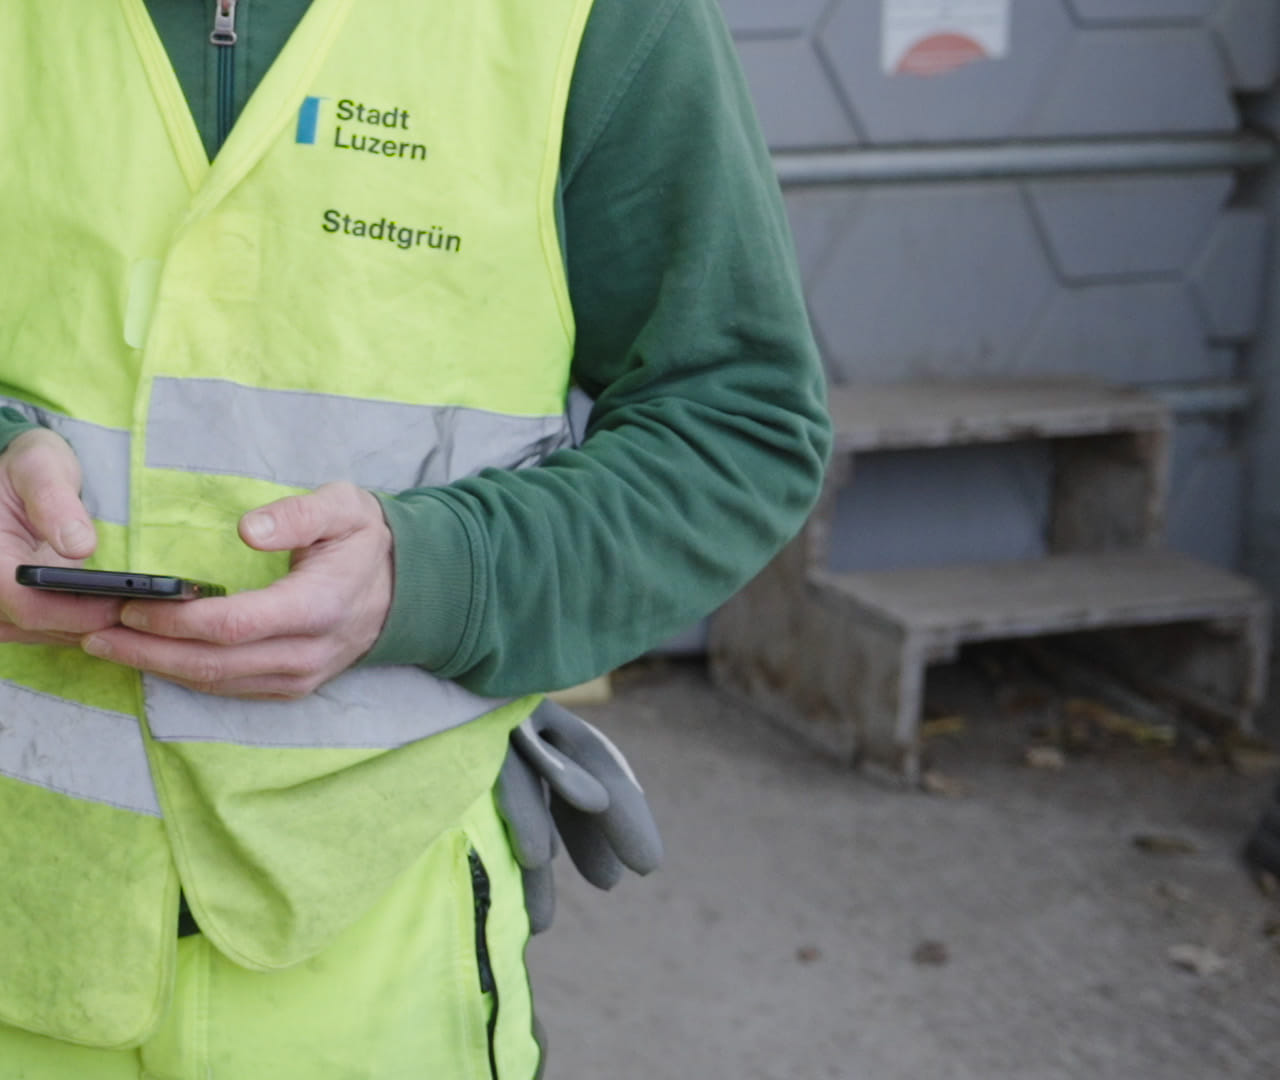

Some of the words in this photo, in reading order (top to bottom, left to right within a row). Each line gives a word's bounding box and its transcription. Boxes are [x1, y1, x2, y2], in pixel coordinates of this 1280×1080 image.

[335, 99, 410, 130] Stadt
[333, 126, 427, 160] Luzern
[321, 209, 461, 253] Stadtgrün
